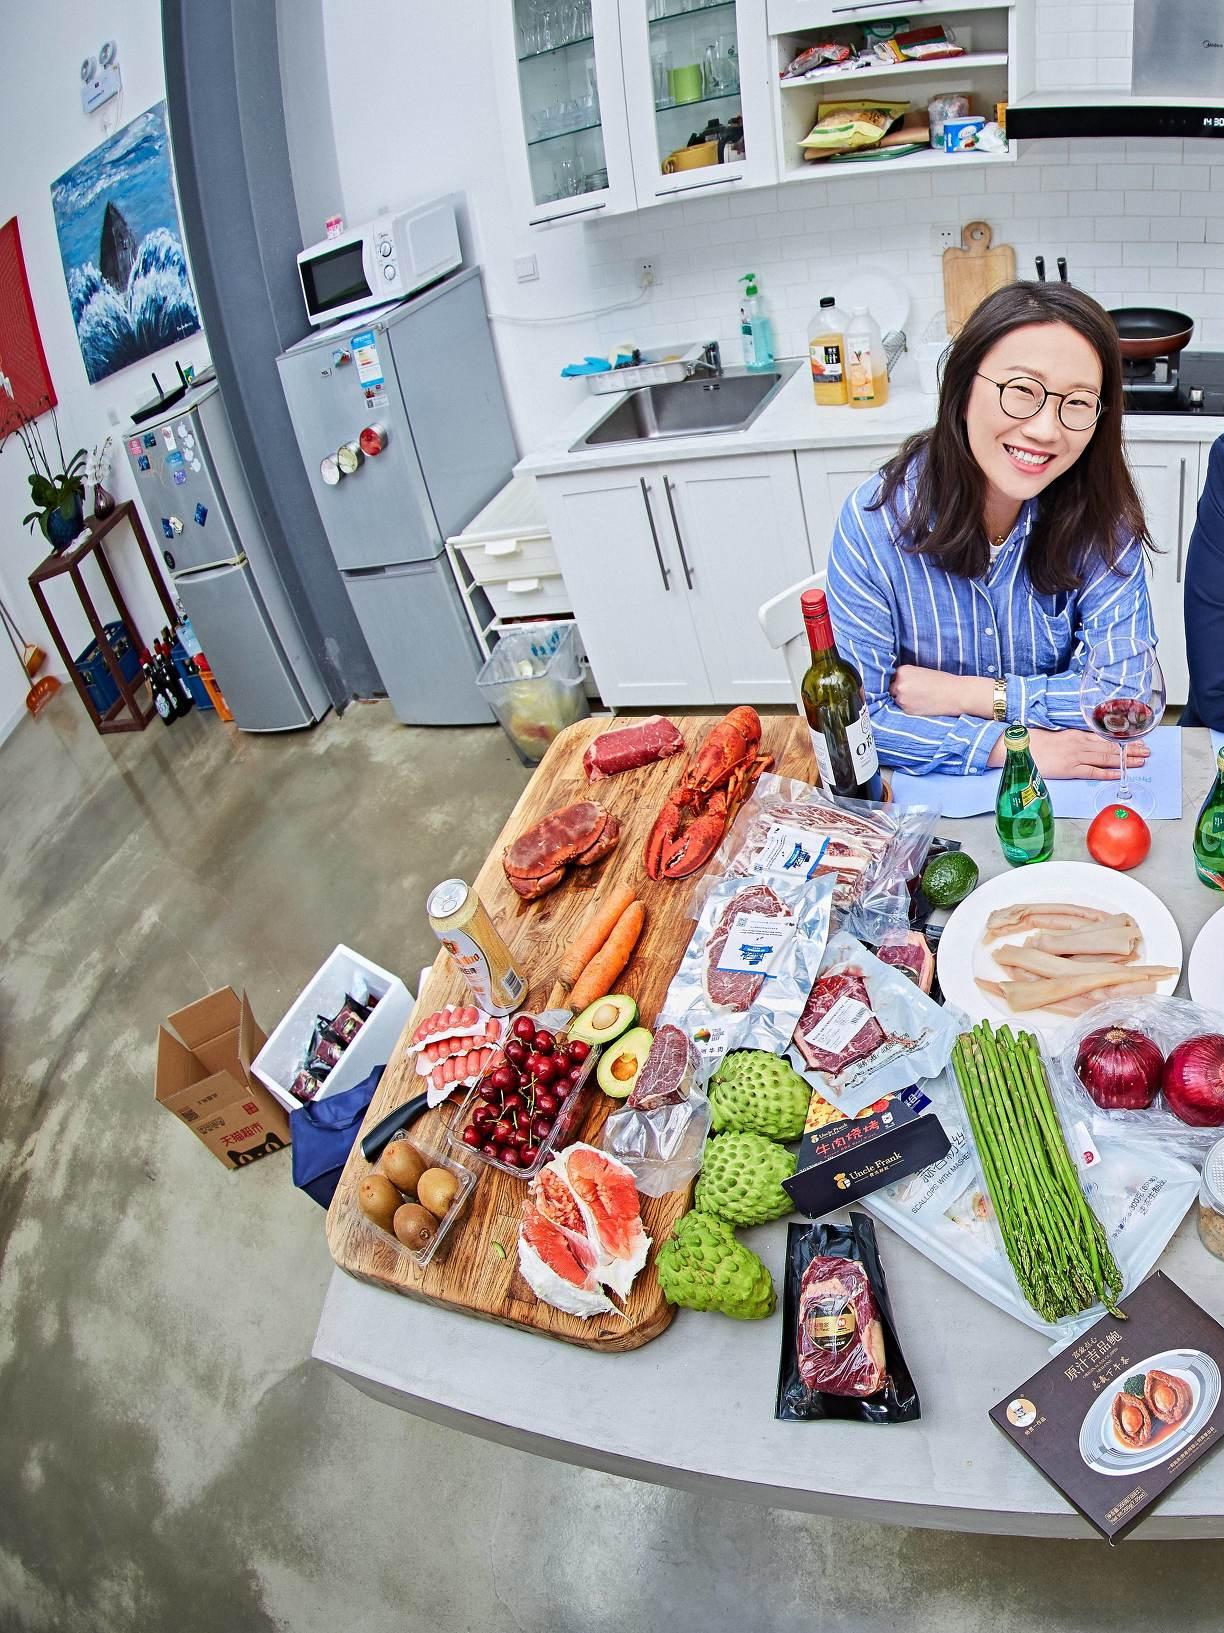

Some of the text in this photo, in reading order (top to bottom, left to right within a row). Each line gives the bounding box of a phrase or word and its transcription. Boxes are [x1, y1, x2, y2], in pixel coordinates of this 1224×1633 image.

[220, 1121, 264, 1147] 天猫超市
[815, 1120, 880, 1155] 牛肉烧烤
[849, 1152, 902, 1181] Uncle Frank
[937, 1171, 952, 1185] WITH
[950, 1151, 970, 1172] MASHE
[1064, 1330, 1122, 1381] 原汁吉品鲍
